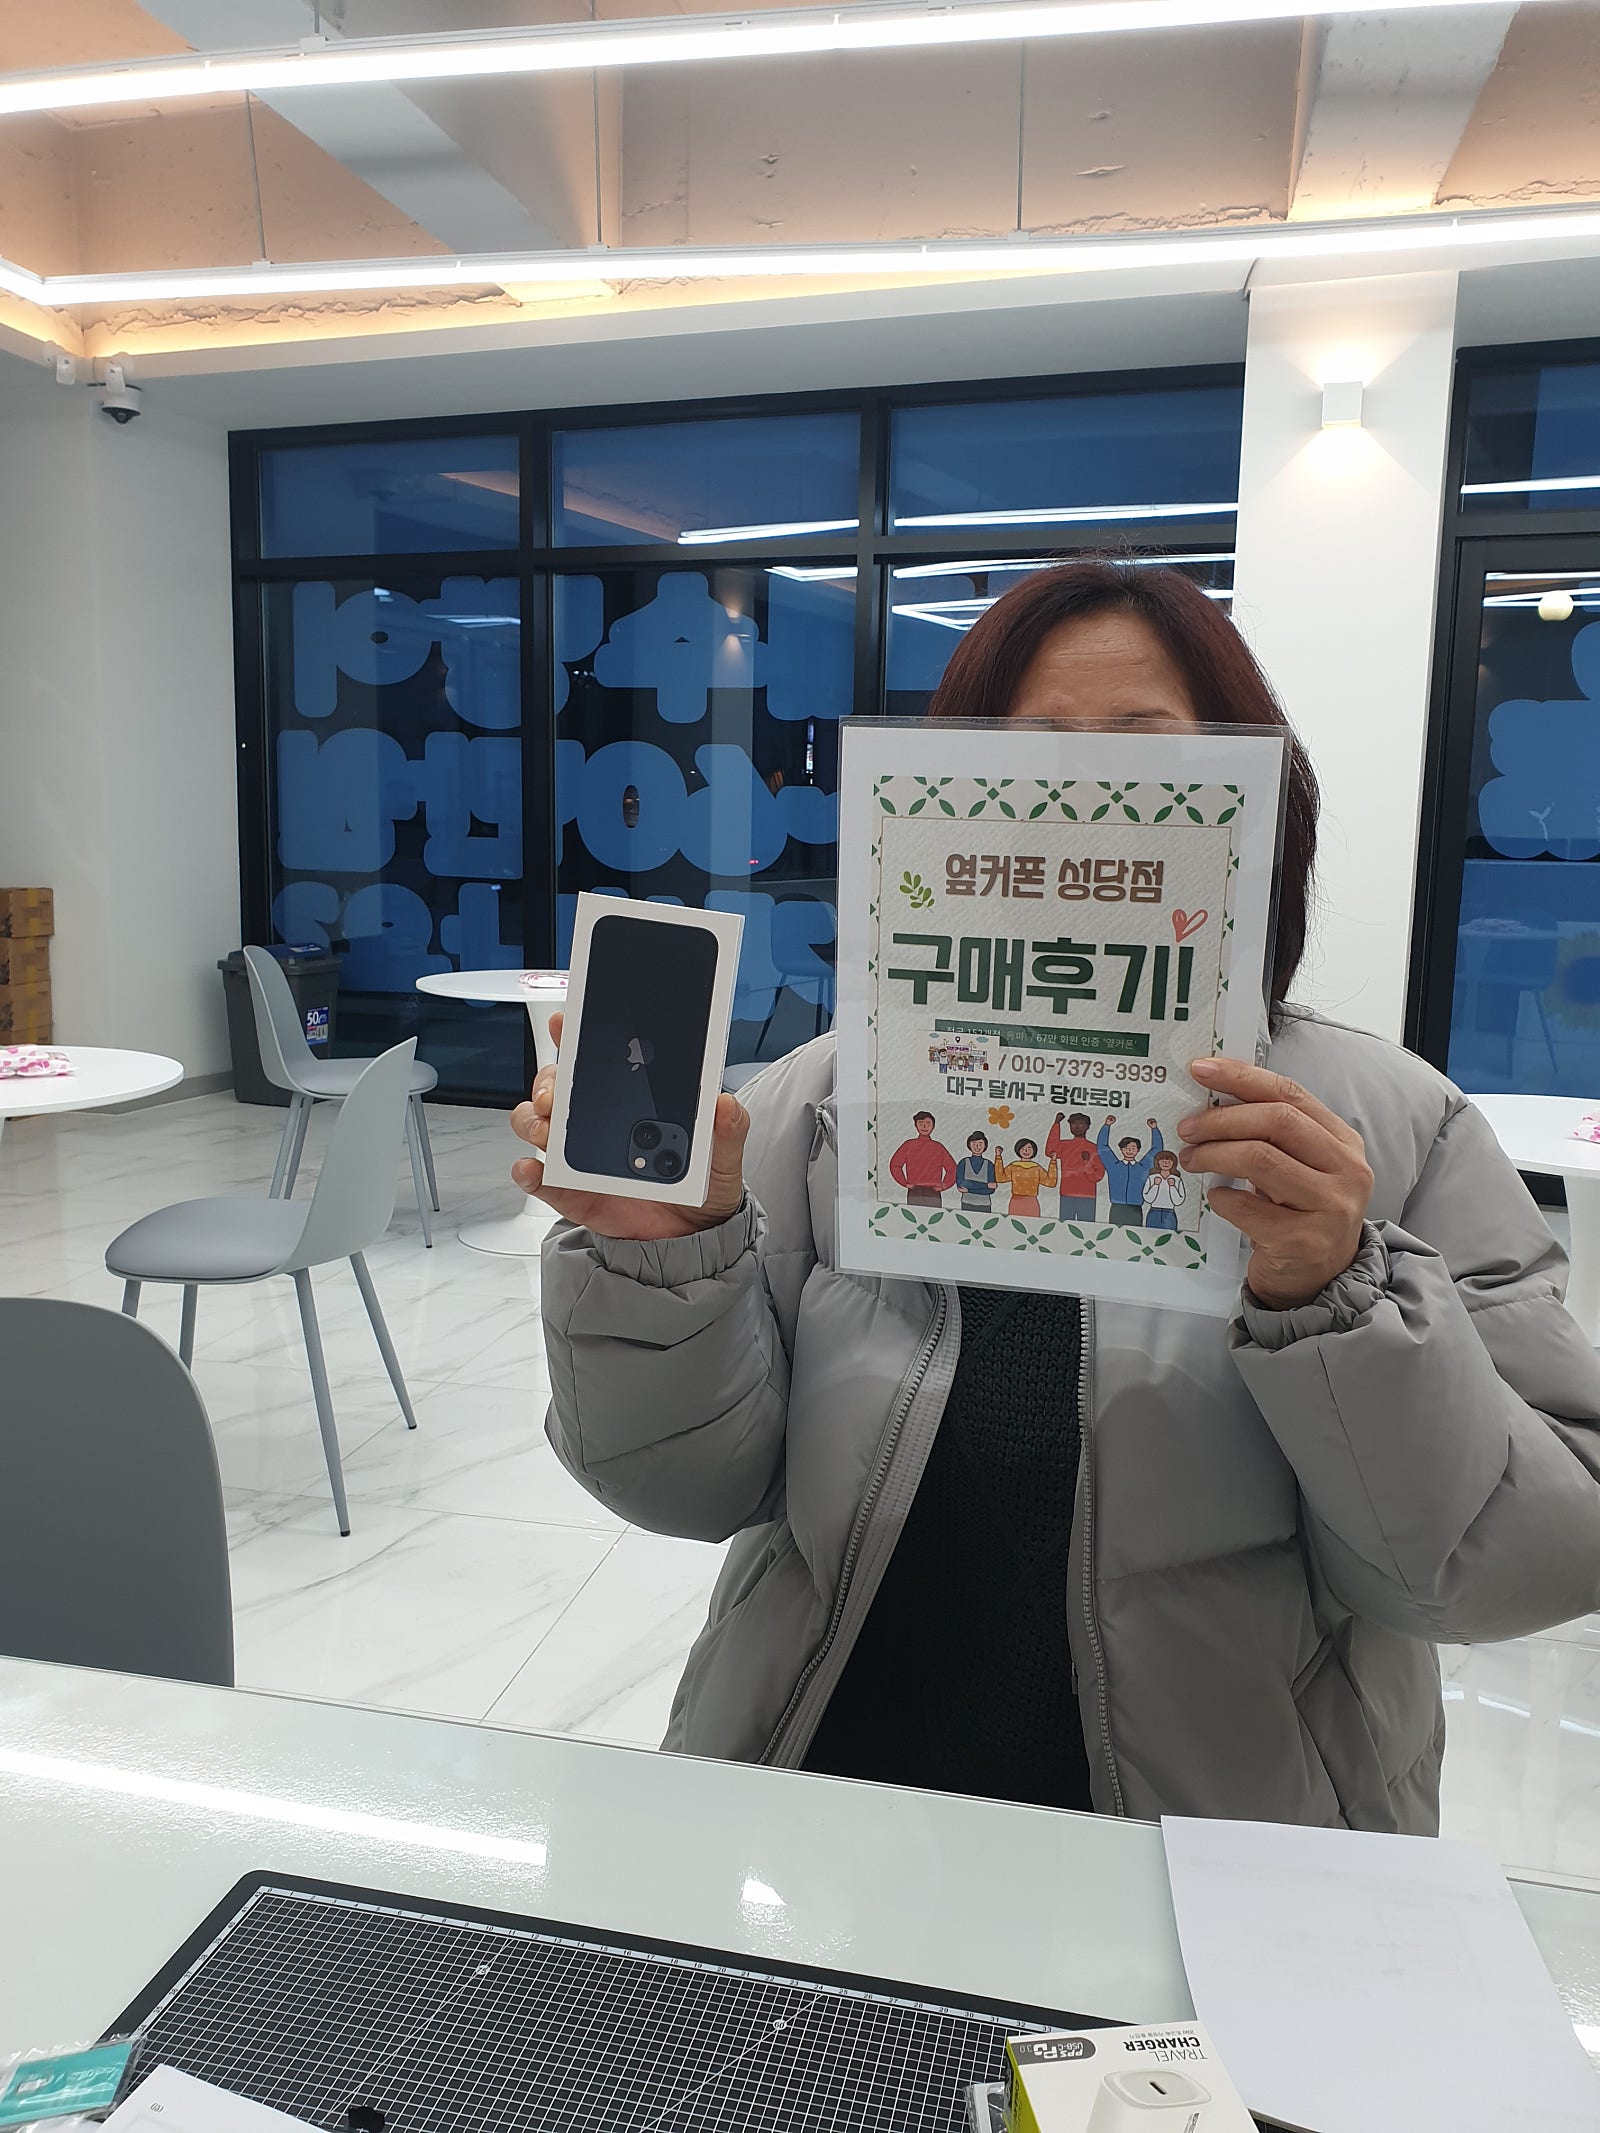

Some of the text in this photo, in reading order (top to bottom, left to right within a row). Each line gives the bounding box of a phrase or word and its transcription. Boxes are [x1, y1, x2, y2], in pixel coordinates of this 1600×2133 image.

[945, 853, 1165, 903] 옆커폰 성당점
[888, 932, 1194, 1021] 구매후기!
[1036, 1033, 1057, 1044] 67만
[1060, 1035, 1079, 1046] 회원
[1081, 1036, 1100, 1048] 인증
[1011, 1054, 1167, 1084] 010-7373-3939
[946, 1076, 1131, 1109] 대구 달서구 당산로81
[1019, 2044, 1032, 2053] 3.0
[1057, 2041, 1084, 2051] USB-C
[1123, 2036, 1201, 2052] CHARGER
[1060, 2048, 1084, 2058] PPS
[1148, 2048, 1208, 2062] TRAVEL
